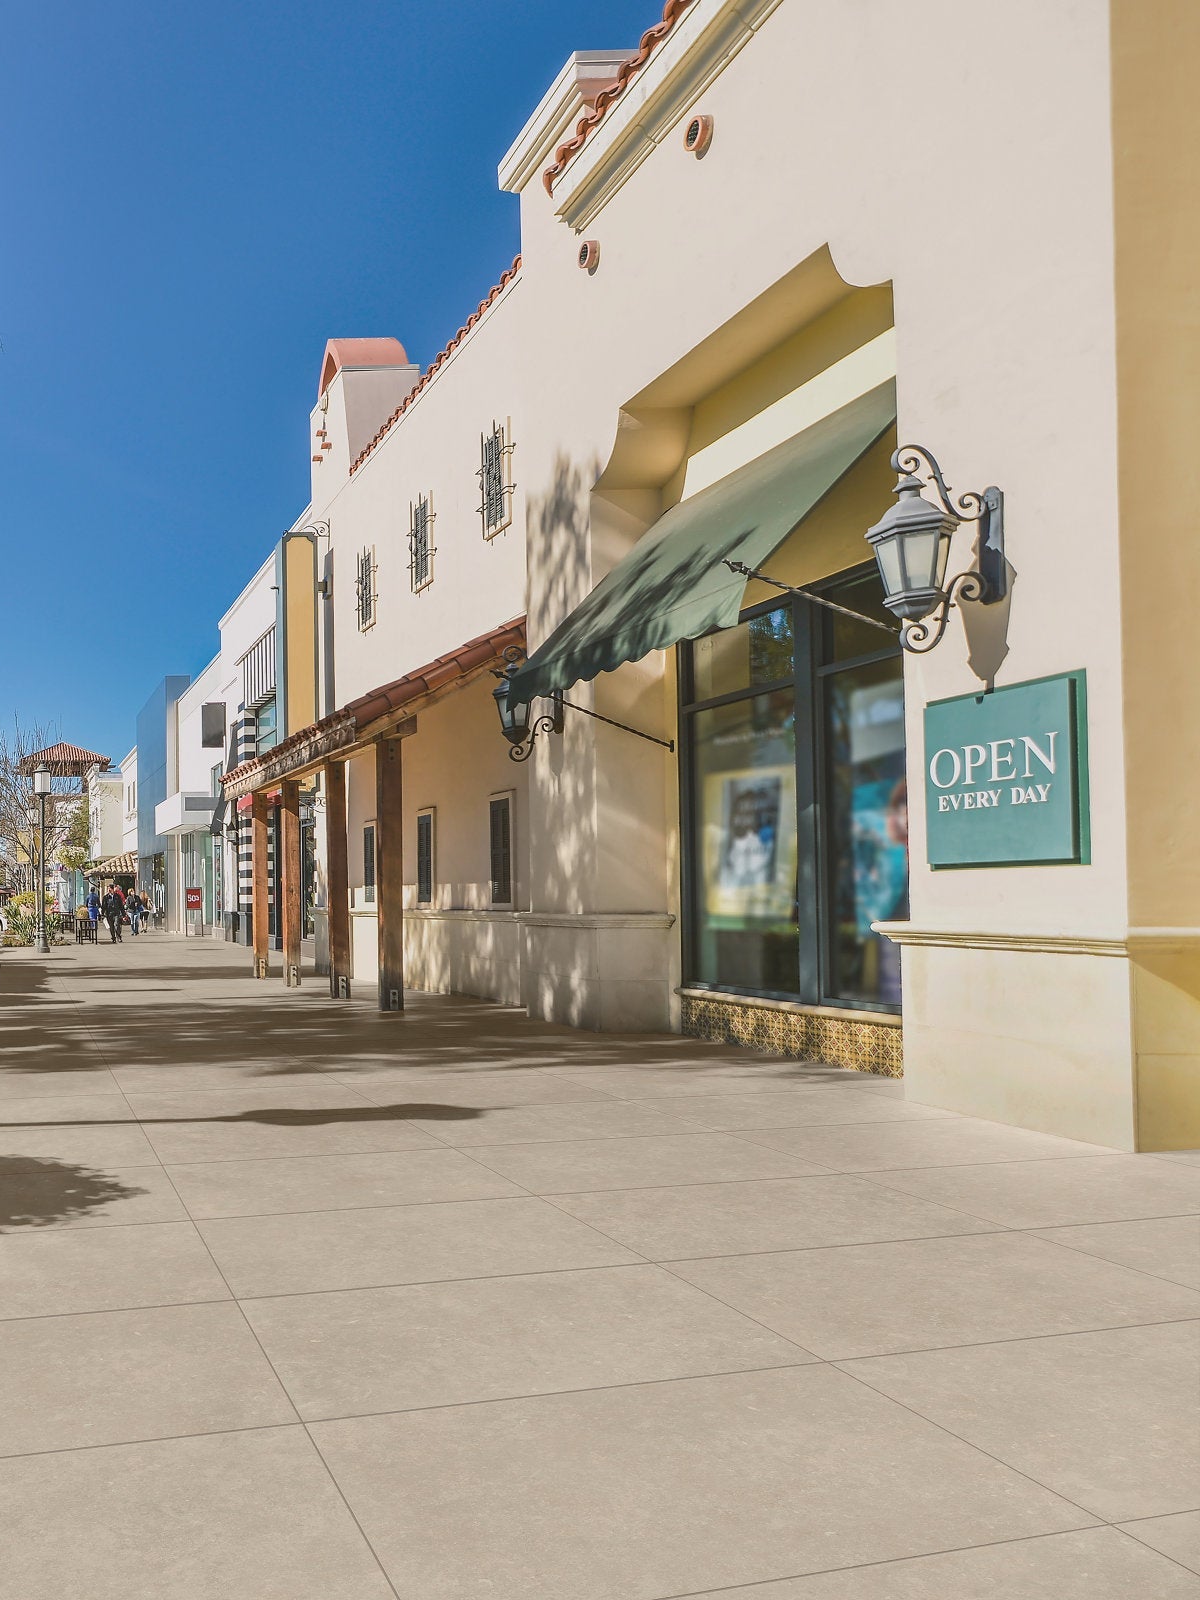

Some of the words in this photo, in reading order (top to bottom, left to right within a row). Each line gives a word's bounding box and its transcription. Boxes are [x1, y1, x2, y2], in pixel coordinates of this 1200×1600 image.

[929, 731, 1059, 789] OPEN
[938, 789, 1002, 812] EVERY
[1010, 783, 1052, 805] DAY
